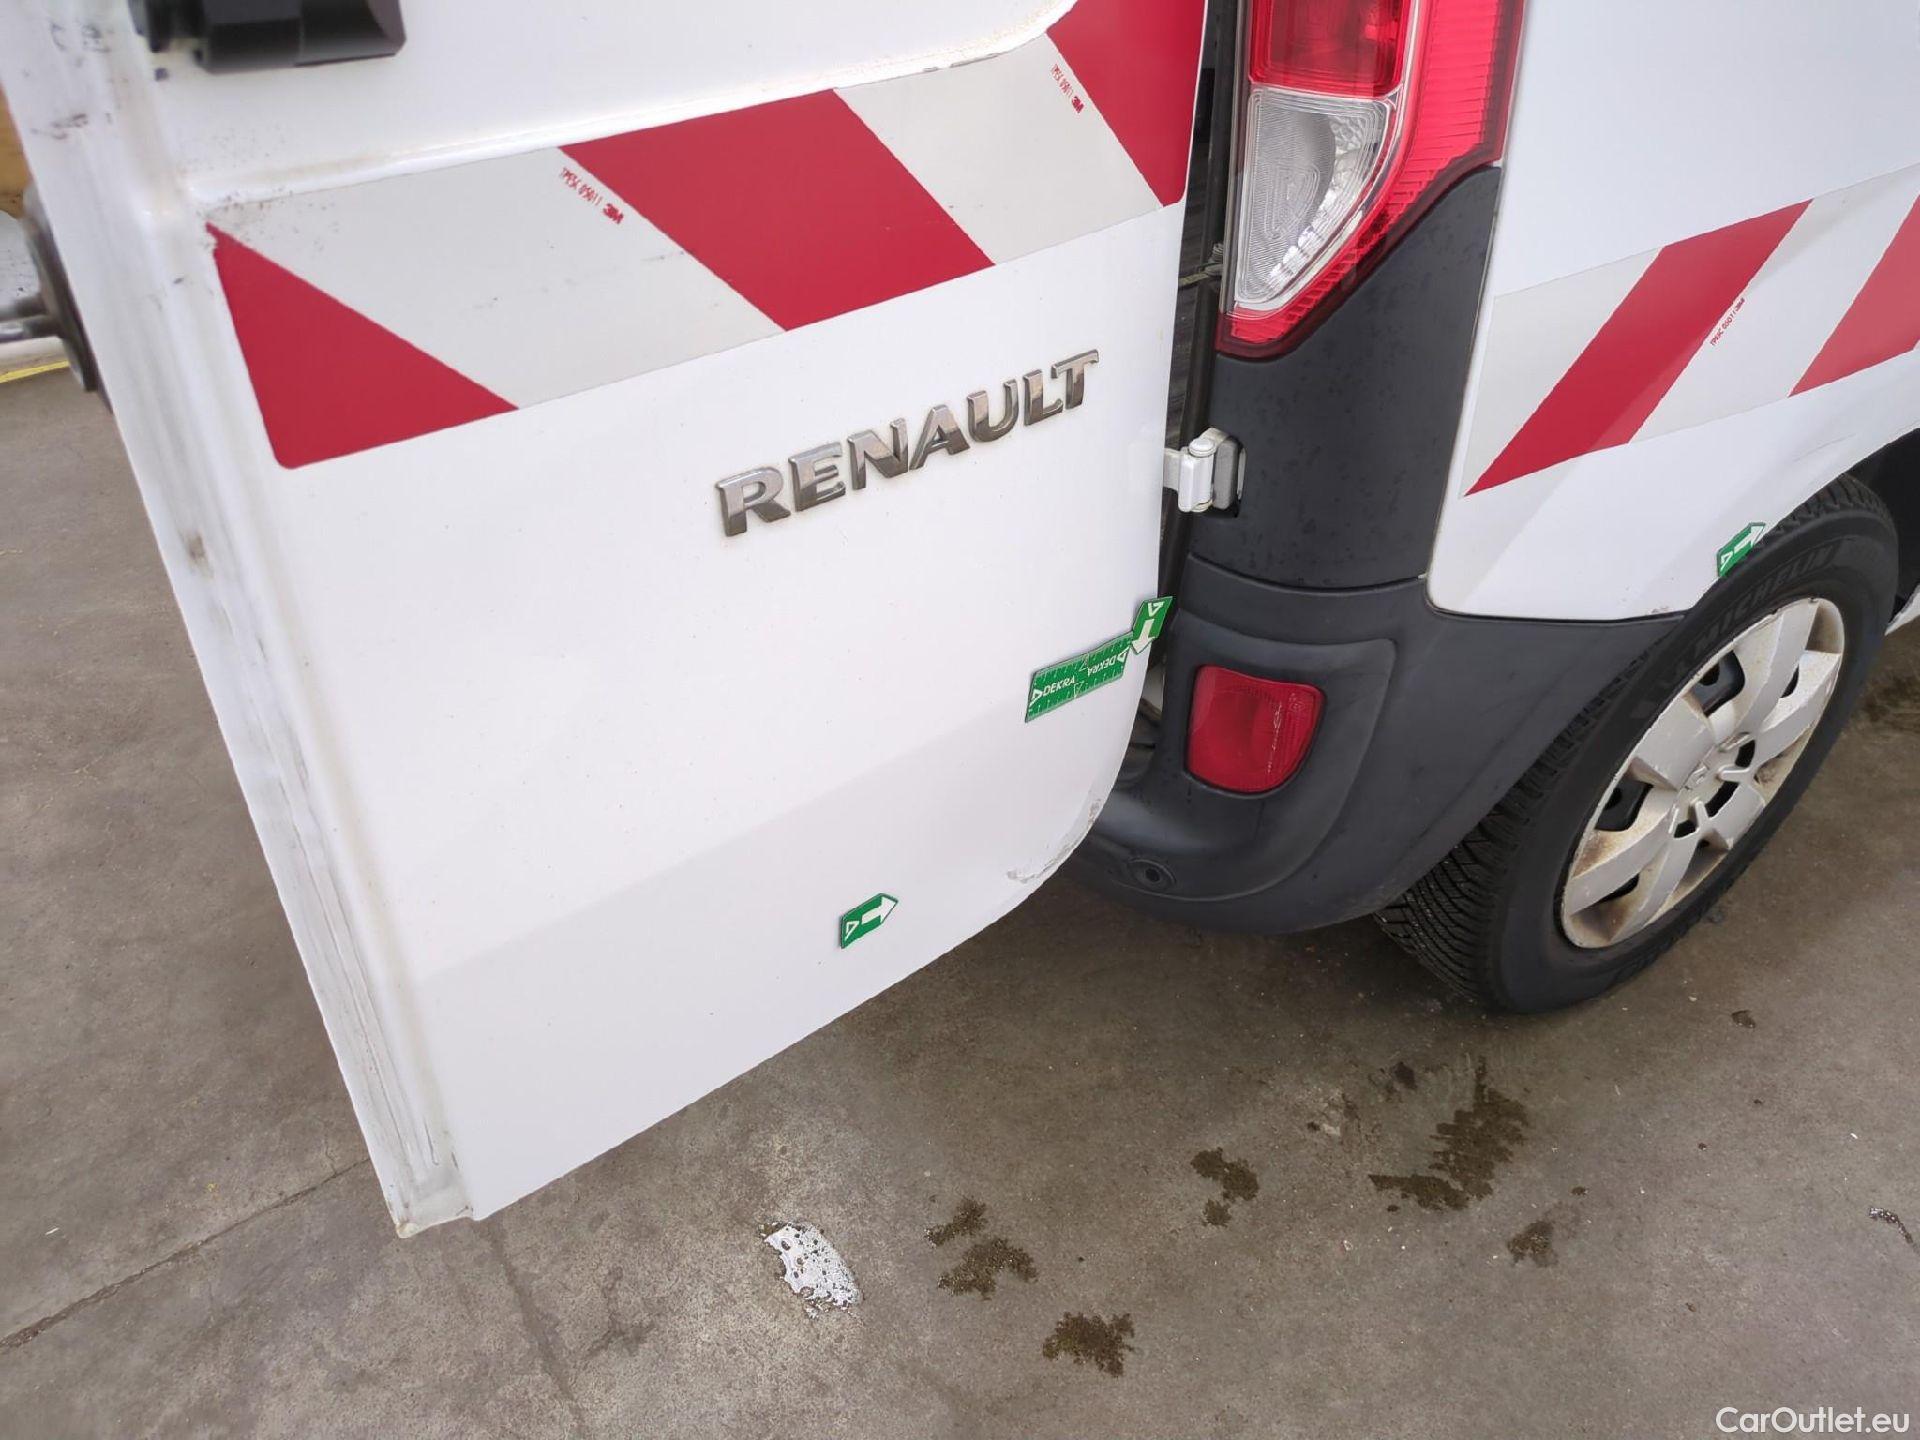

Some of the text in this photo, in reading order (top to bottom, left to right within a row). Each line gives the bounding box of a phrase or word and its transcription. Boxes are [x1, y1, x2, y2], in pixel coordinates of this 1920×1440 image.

[1071, 96, 1084, 113] 3M
[603, 203, 624, 224] 3M
[715, 348, 1099, 537] RENAULT
[1697, 542, 1838, 653] MICHELIN
[1087, 655, 1116, 677] DEKRA
[1043, 675, 1075, 697] DEKRA
